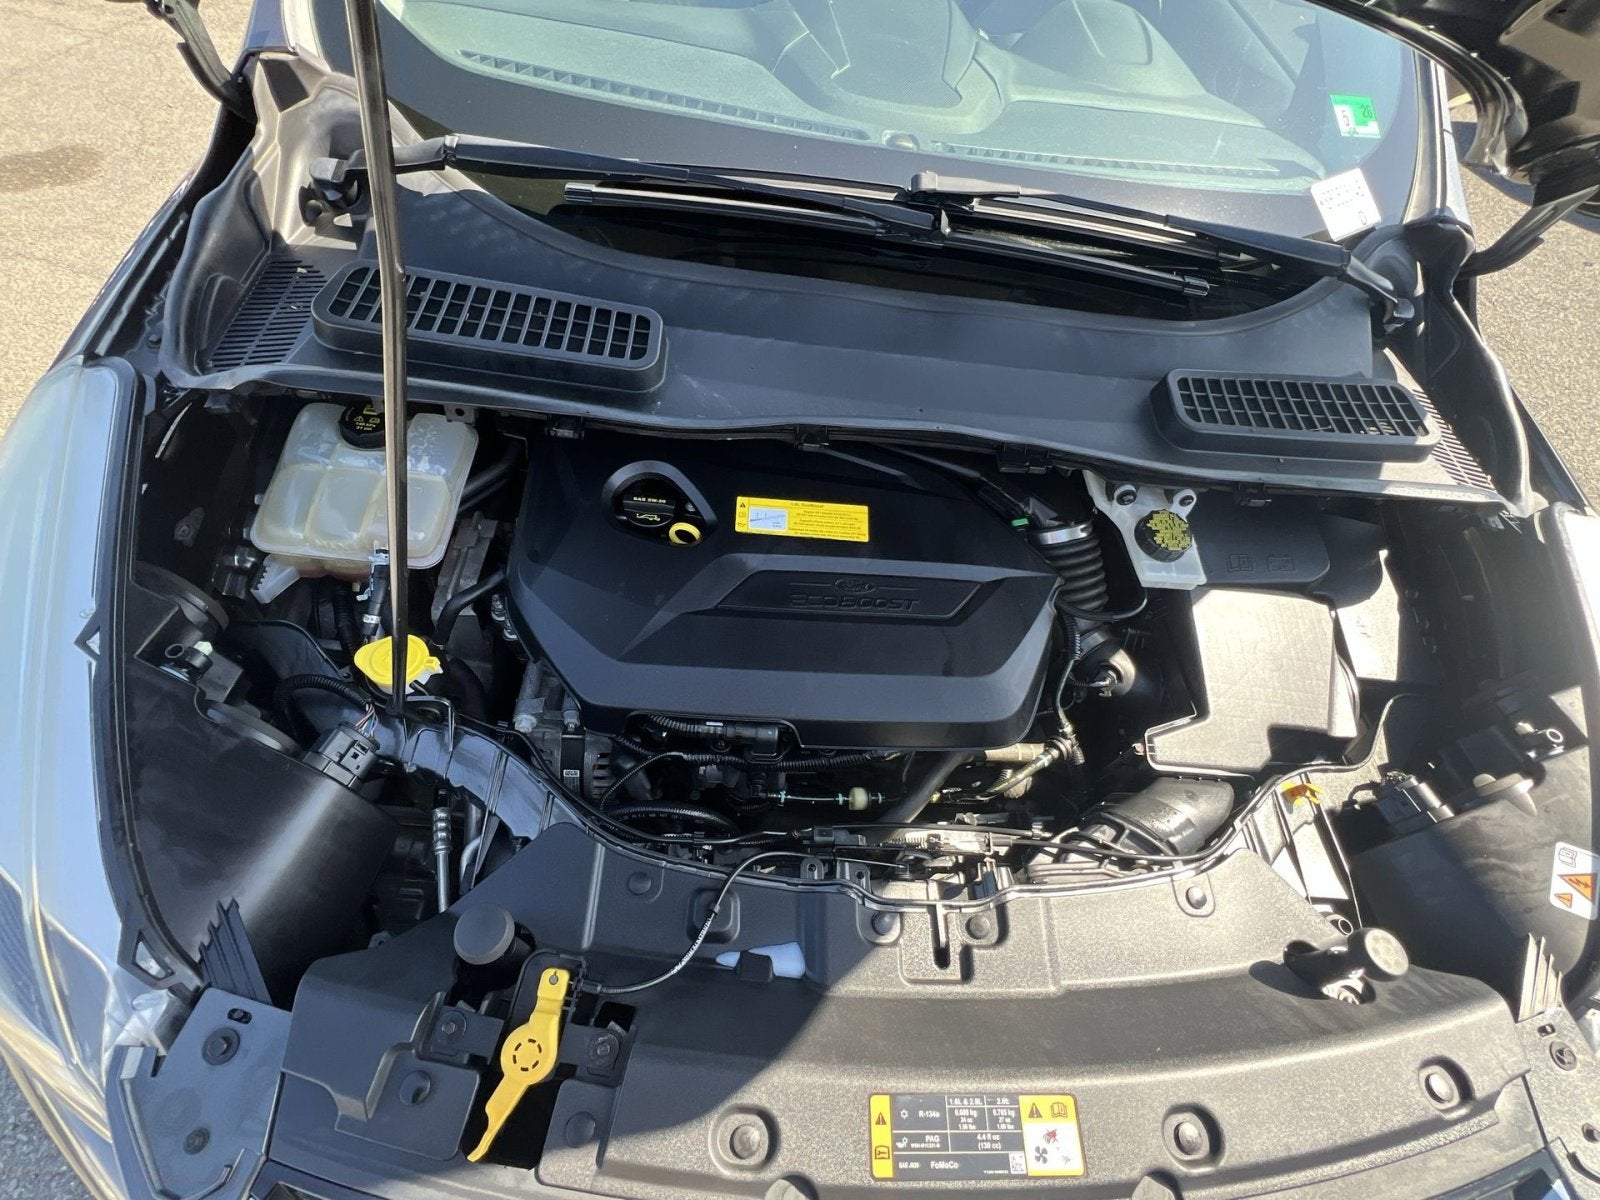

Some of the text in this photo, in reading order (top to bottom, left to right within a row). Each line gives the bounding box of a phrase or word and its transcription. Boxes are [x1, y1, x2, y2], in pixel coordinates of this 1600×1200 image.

[1360, 104, 1373, 119] 26
[963, 1097, 969, 1105] &
[918, 1110, 940, 1118] R-134a
[970, 1108, 978, 1118] kg
[1008, 1109, 1015, 1118] kg
[925, 1135, 940, 1143] PAG
[976, 1133, 986, 1141] 4.4
[930, 1160, 959, 1170] FoMoCo
